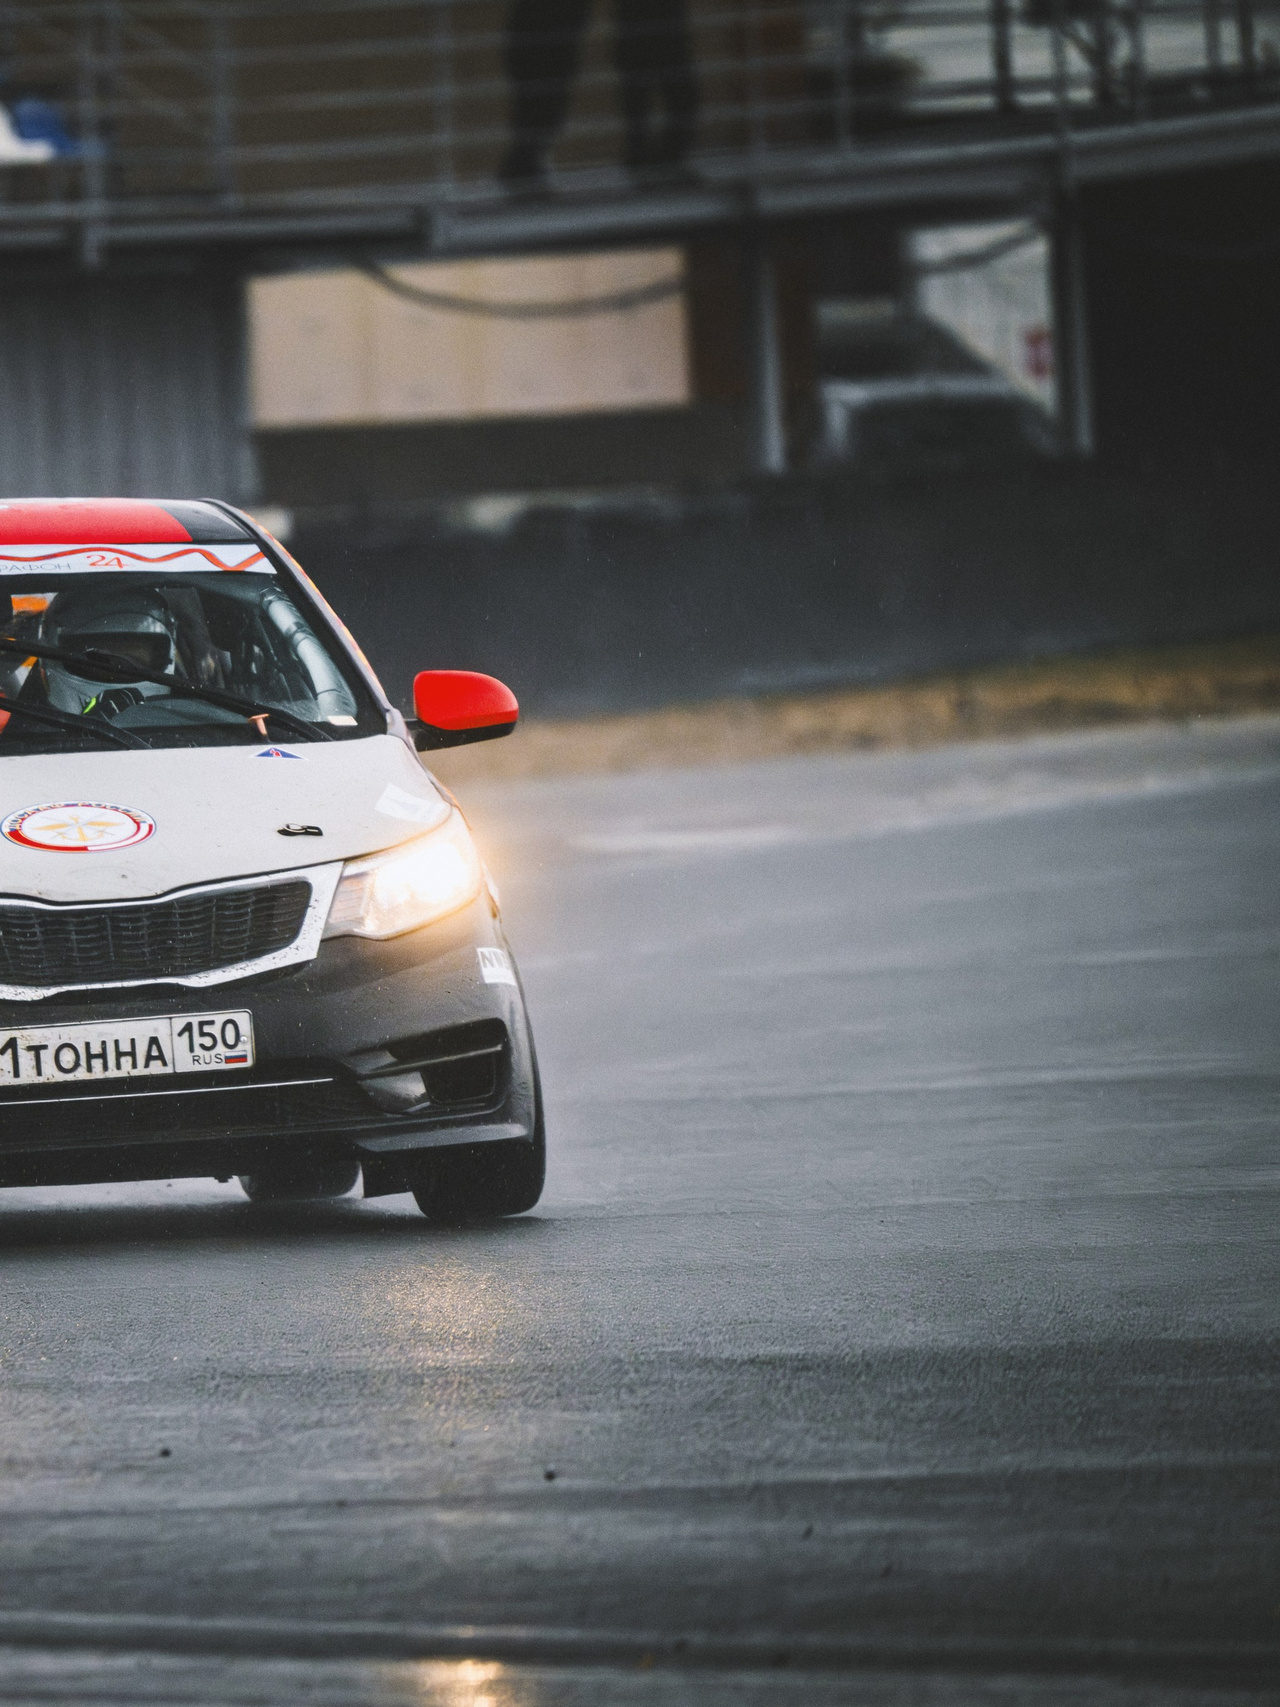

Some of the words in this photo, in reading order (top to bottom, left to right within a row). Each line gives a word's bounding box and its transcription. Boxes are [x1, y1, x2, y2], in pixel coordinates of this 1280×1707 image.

[86, 554, 130, 570] 24
[177, 1019, 241, 1054] 150
[192, 1053, 224, 1066] RUS
